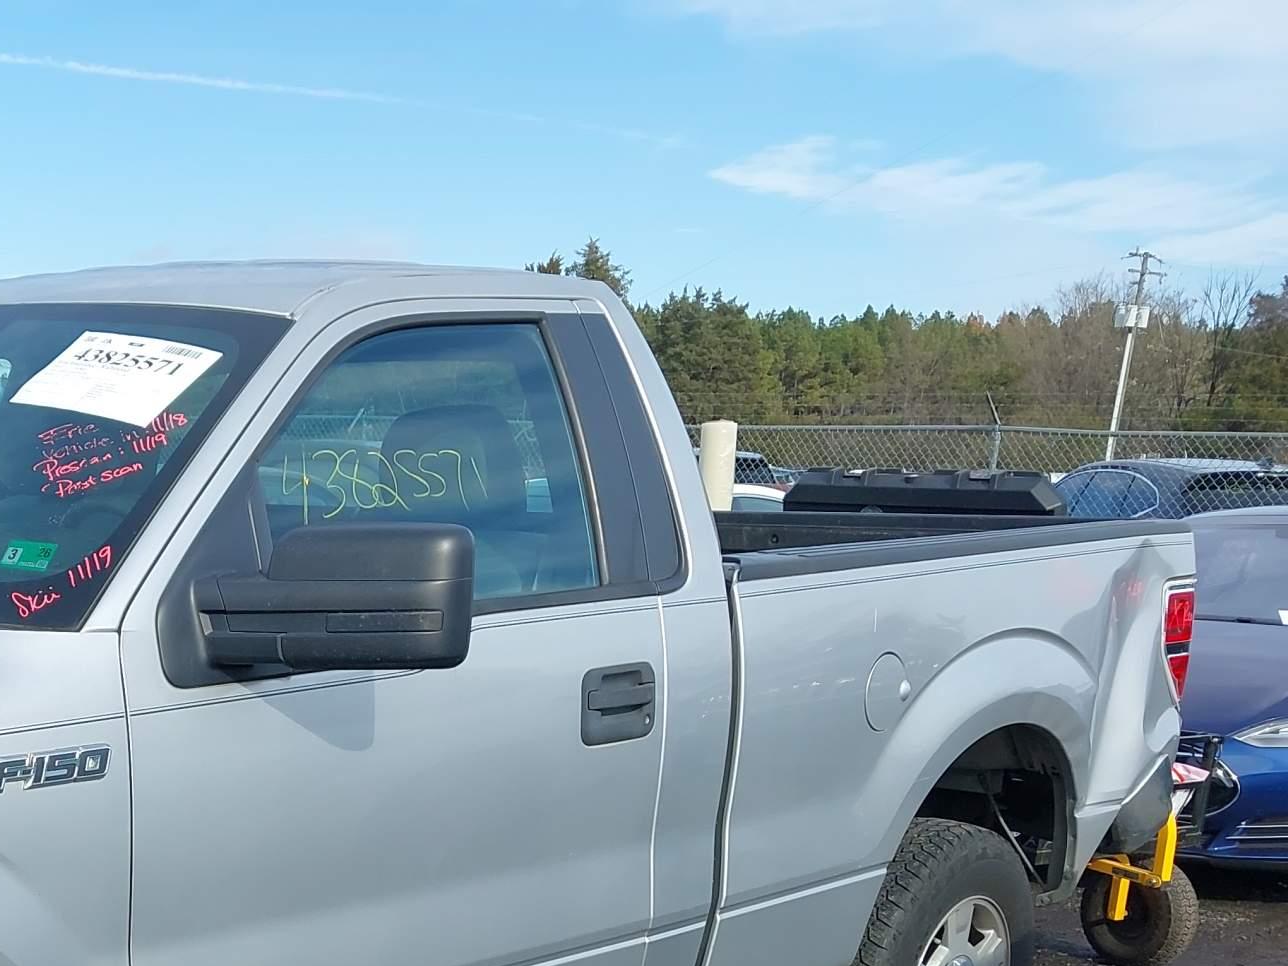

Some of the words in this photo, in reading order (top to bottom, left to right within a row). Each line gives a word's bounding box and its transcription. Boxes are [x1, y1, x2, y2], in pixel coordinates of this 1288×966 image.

[74, 348, 186, 376] 43825571
[132, 433, 167, 454] 11/19
[282, 449, 488, 525] 43825571
[8, 548, 18, 560] 3
[39, 547, 52, 558] 26
[68, 545, 111, 587] 11/19
